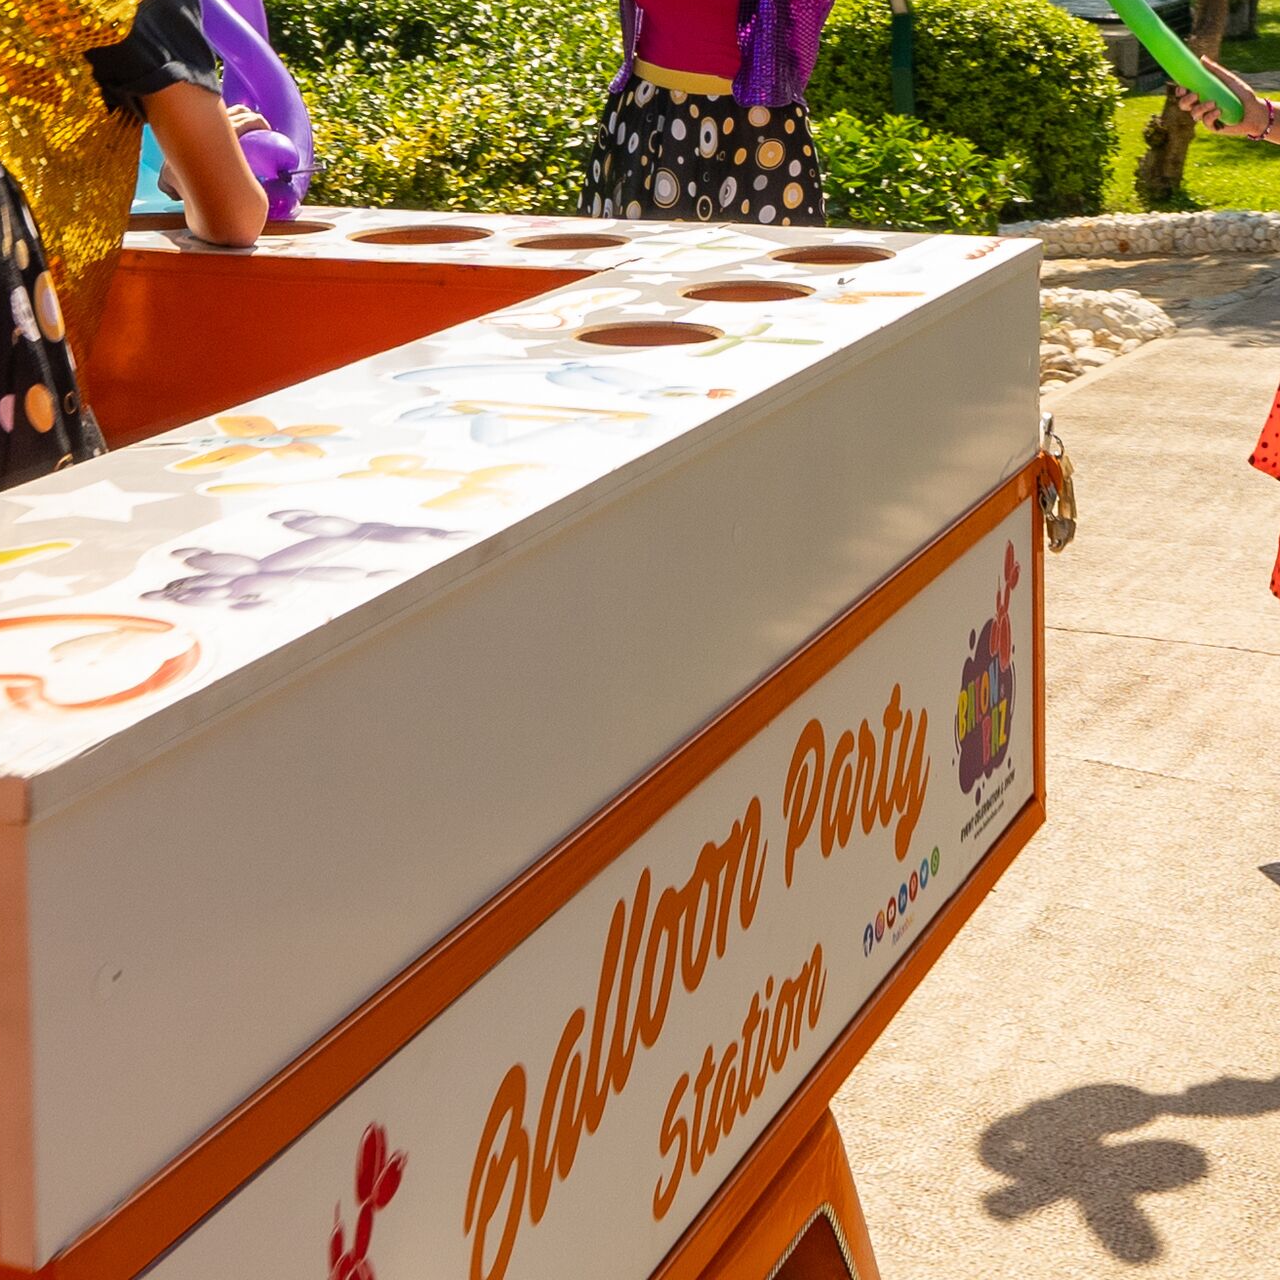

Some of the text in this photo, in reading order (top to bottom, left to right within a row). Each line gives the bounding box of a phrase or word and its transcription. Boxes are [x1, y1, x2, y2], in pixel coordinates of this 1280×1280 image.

[463, 683, 931, 1280] Balloon Party
[653, 943, 828, 1221] Station
